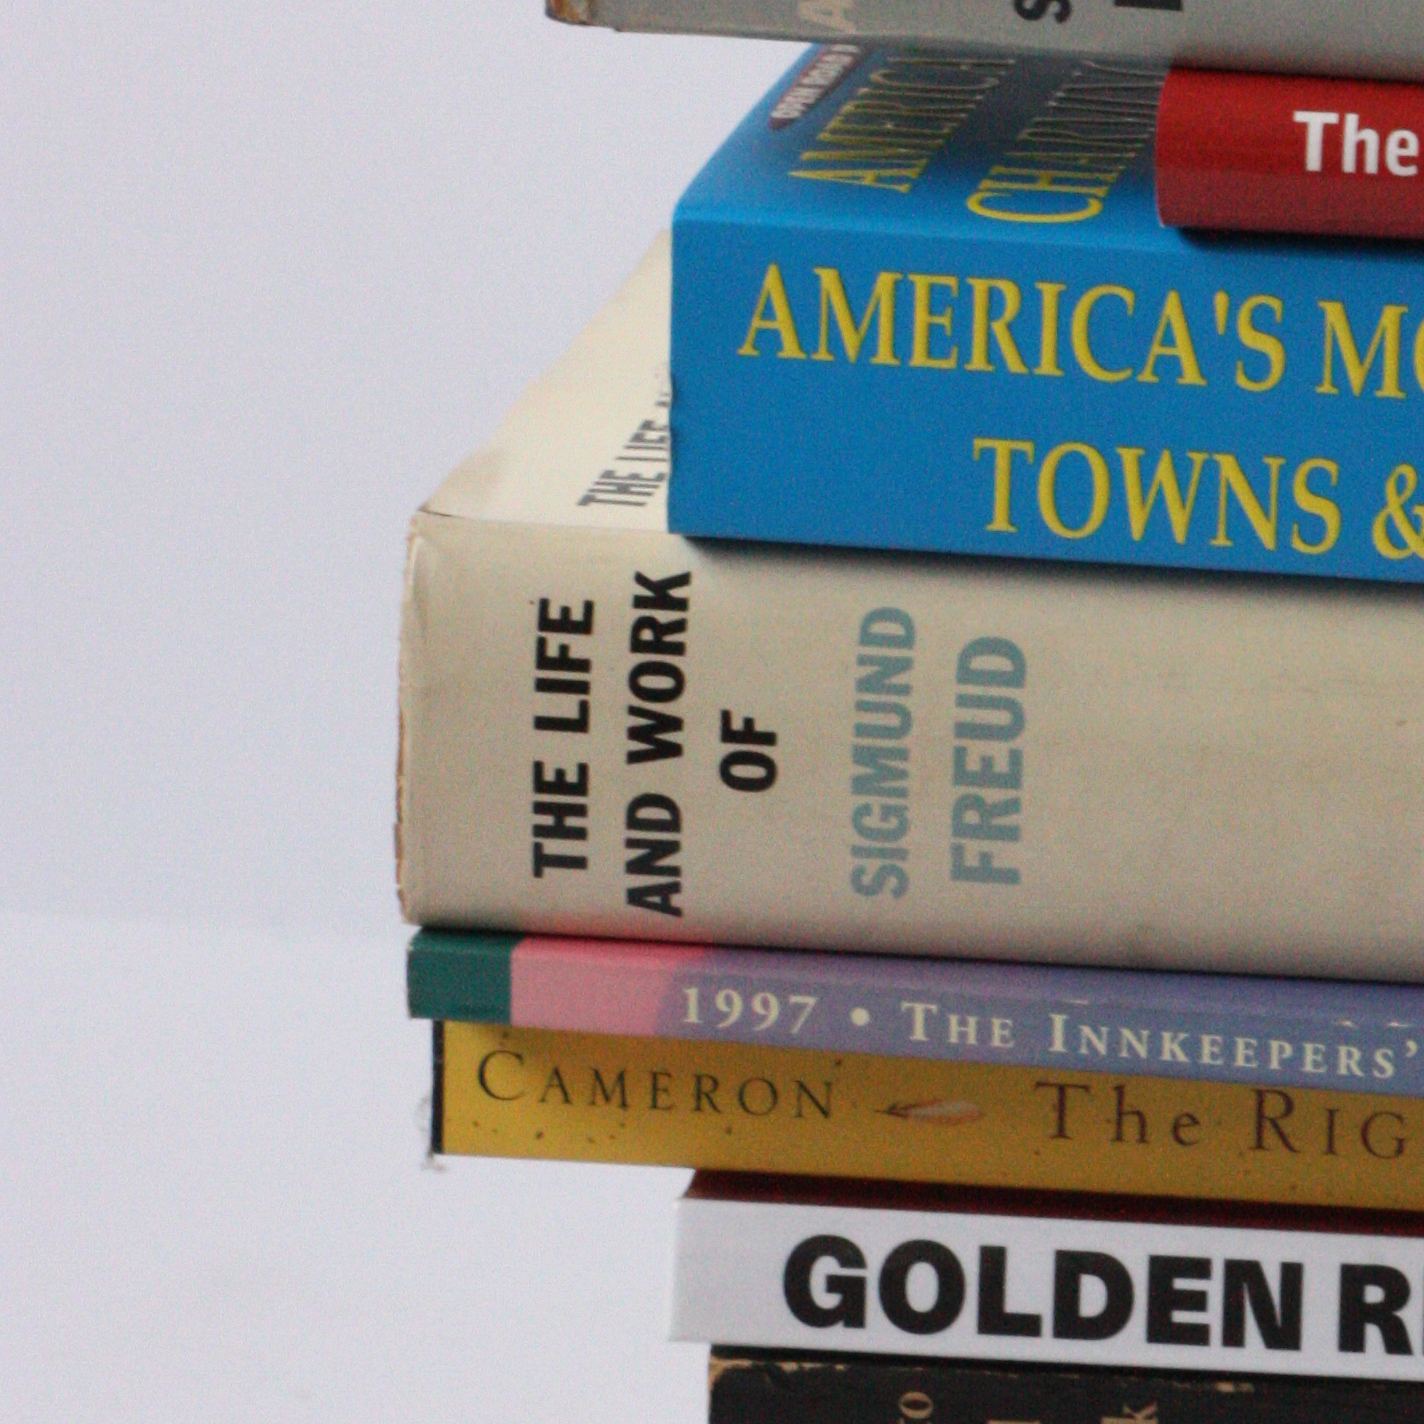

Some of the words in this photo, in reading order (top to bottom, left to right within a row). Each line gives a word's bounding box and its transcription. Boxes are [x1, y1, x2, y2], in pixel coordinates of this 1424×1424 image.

[1292, 110, 1420, 177] The
[737, 262, 1287, 393] AMERICA'S
[577, 469, 668, 508] THE
[972, 436, 1343, 556] TOWNS
[533, 596, 595, 734] LIFE
[625, 569, 693, 766] WORK
[718, 708, 779, 793] OF
[849, 605, 917, 901] SIGMUND
[949, 635, 1028, 886] FREUD
[531, 759, 590, 879] THE
[624, 791, 682, 918] AND
[682, 985, 819, 1034] 1997
[901, 1001, 1017, 1050] THE
[476, 1049, 836, 1120] CAMERON
[1033, 1080, 1202, 1147] The
[782, 1233, 1305, 1353] GOLDEN
